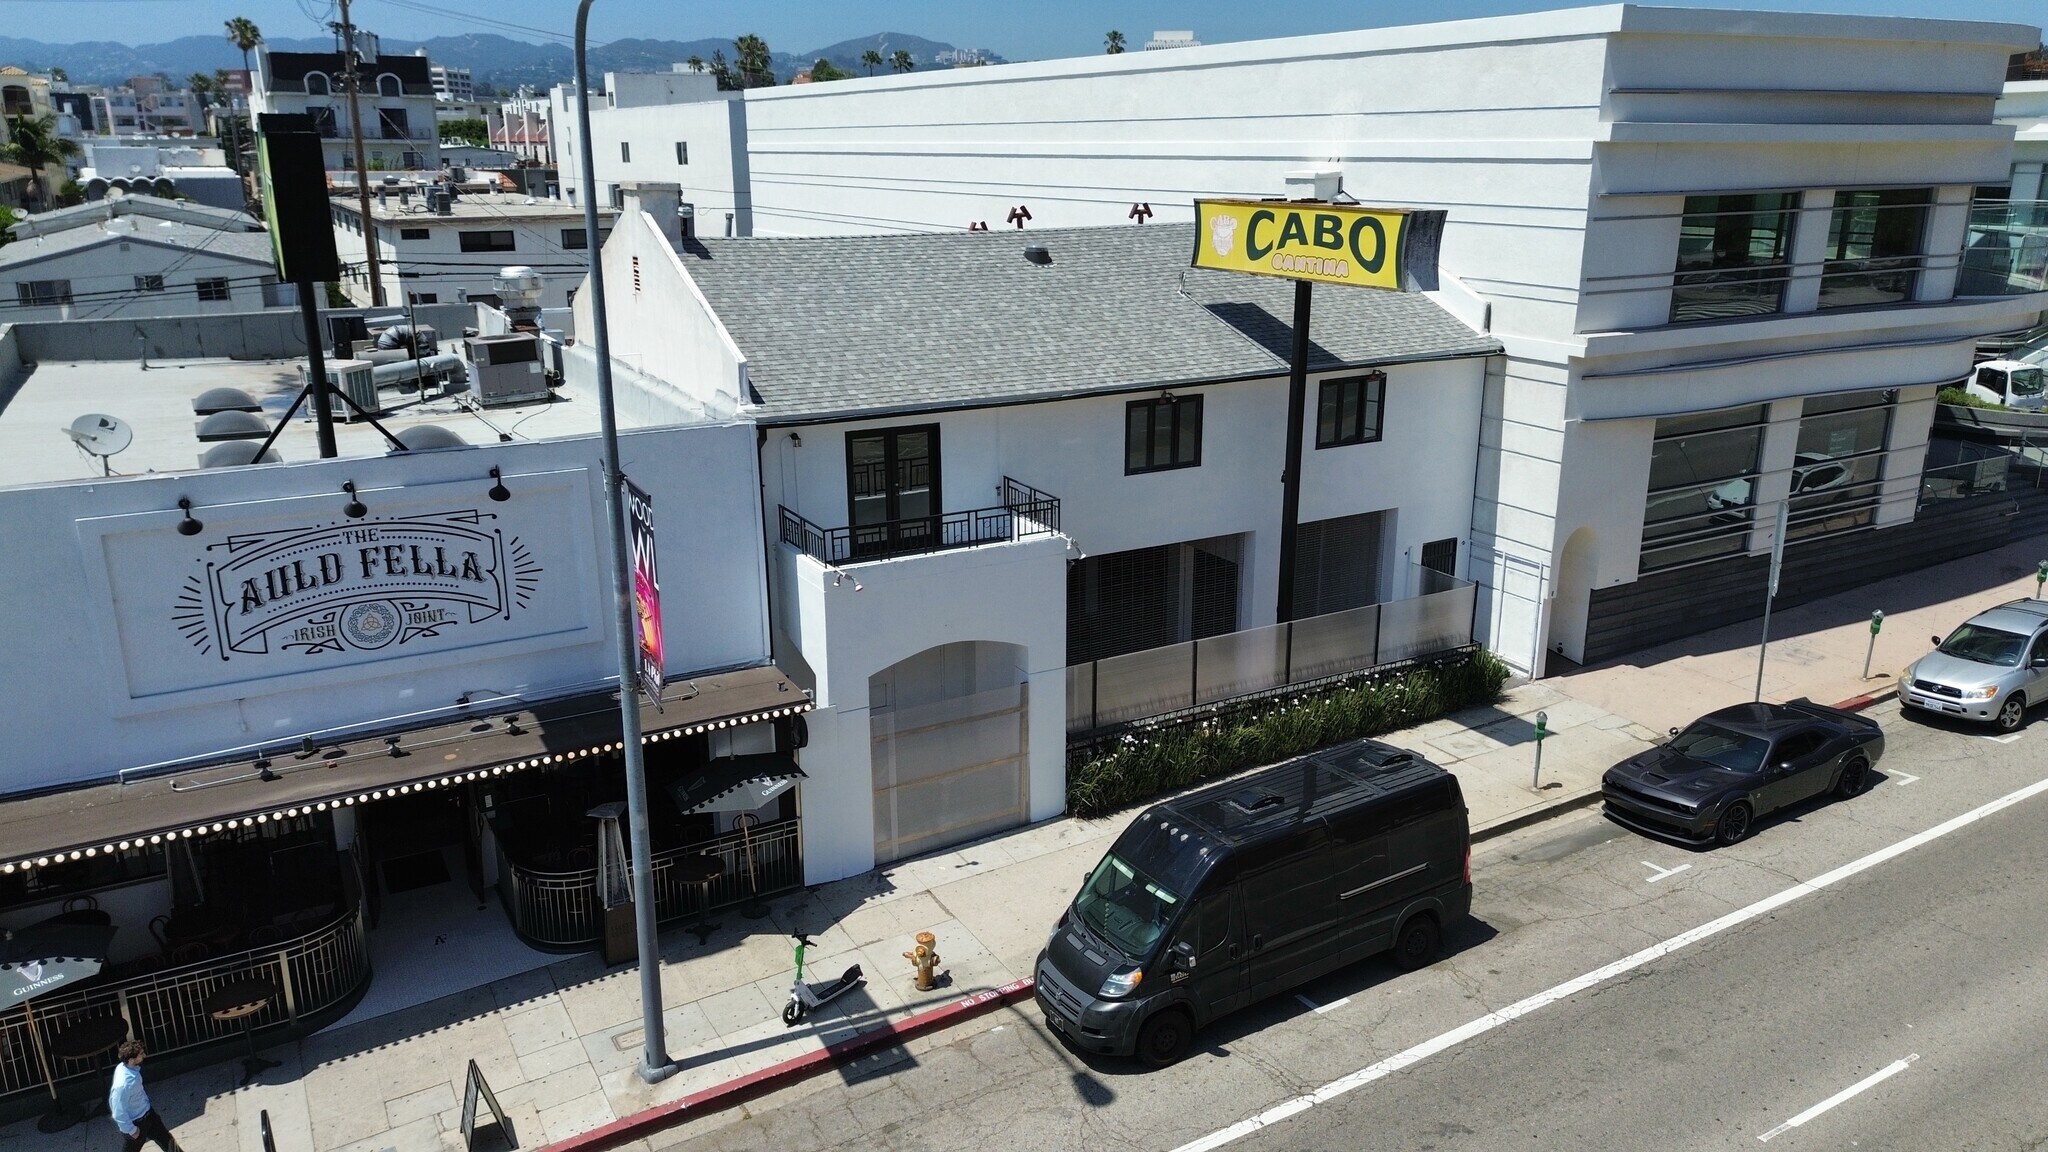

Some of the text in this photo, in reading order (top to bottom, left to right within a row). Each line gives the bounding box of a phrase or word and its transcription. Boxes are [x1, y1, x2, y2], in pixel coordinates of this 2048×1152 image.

[1246, 210, 1386, 274] CABO
[1273, 253, 1350, 278] CANTINA
[342, 528, 379, 545] THE
[239, 544, 487, 615] AULD FELLA
[293, 608, 446, 643] IRISH JOINT
[13, 972, 65, 996] GUINNESS
[960, 998, 975, 1008] NO
